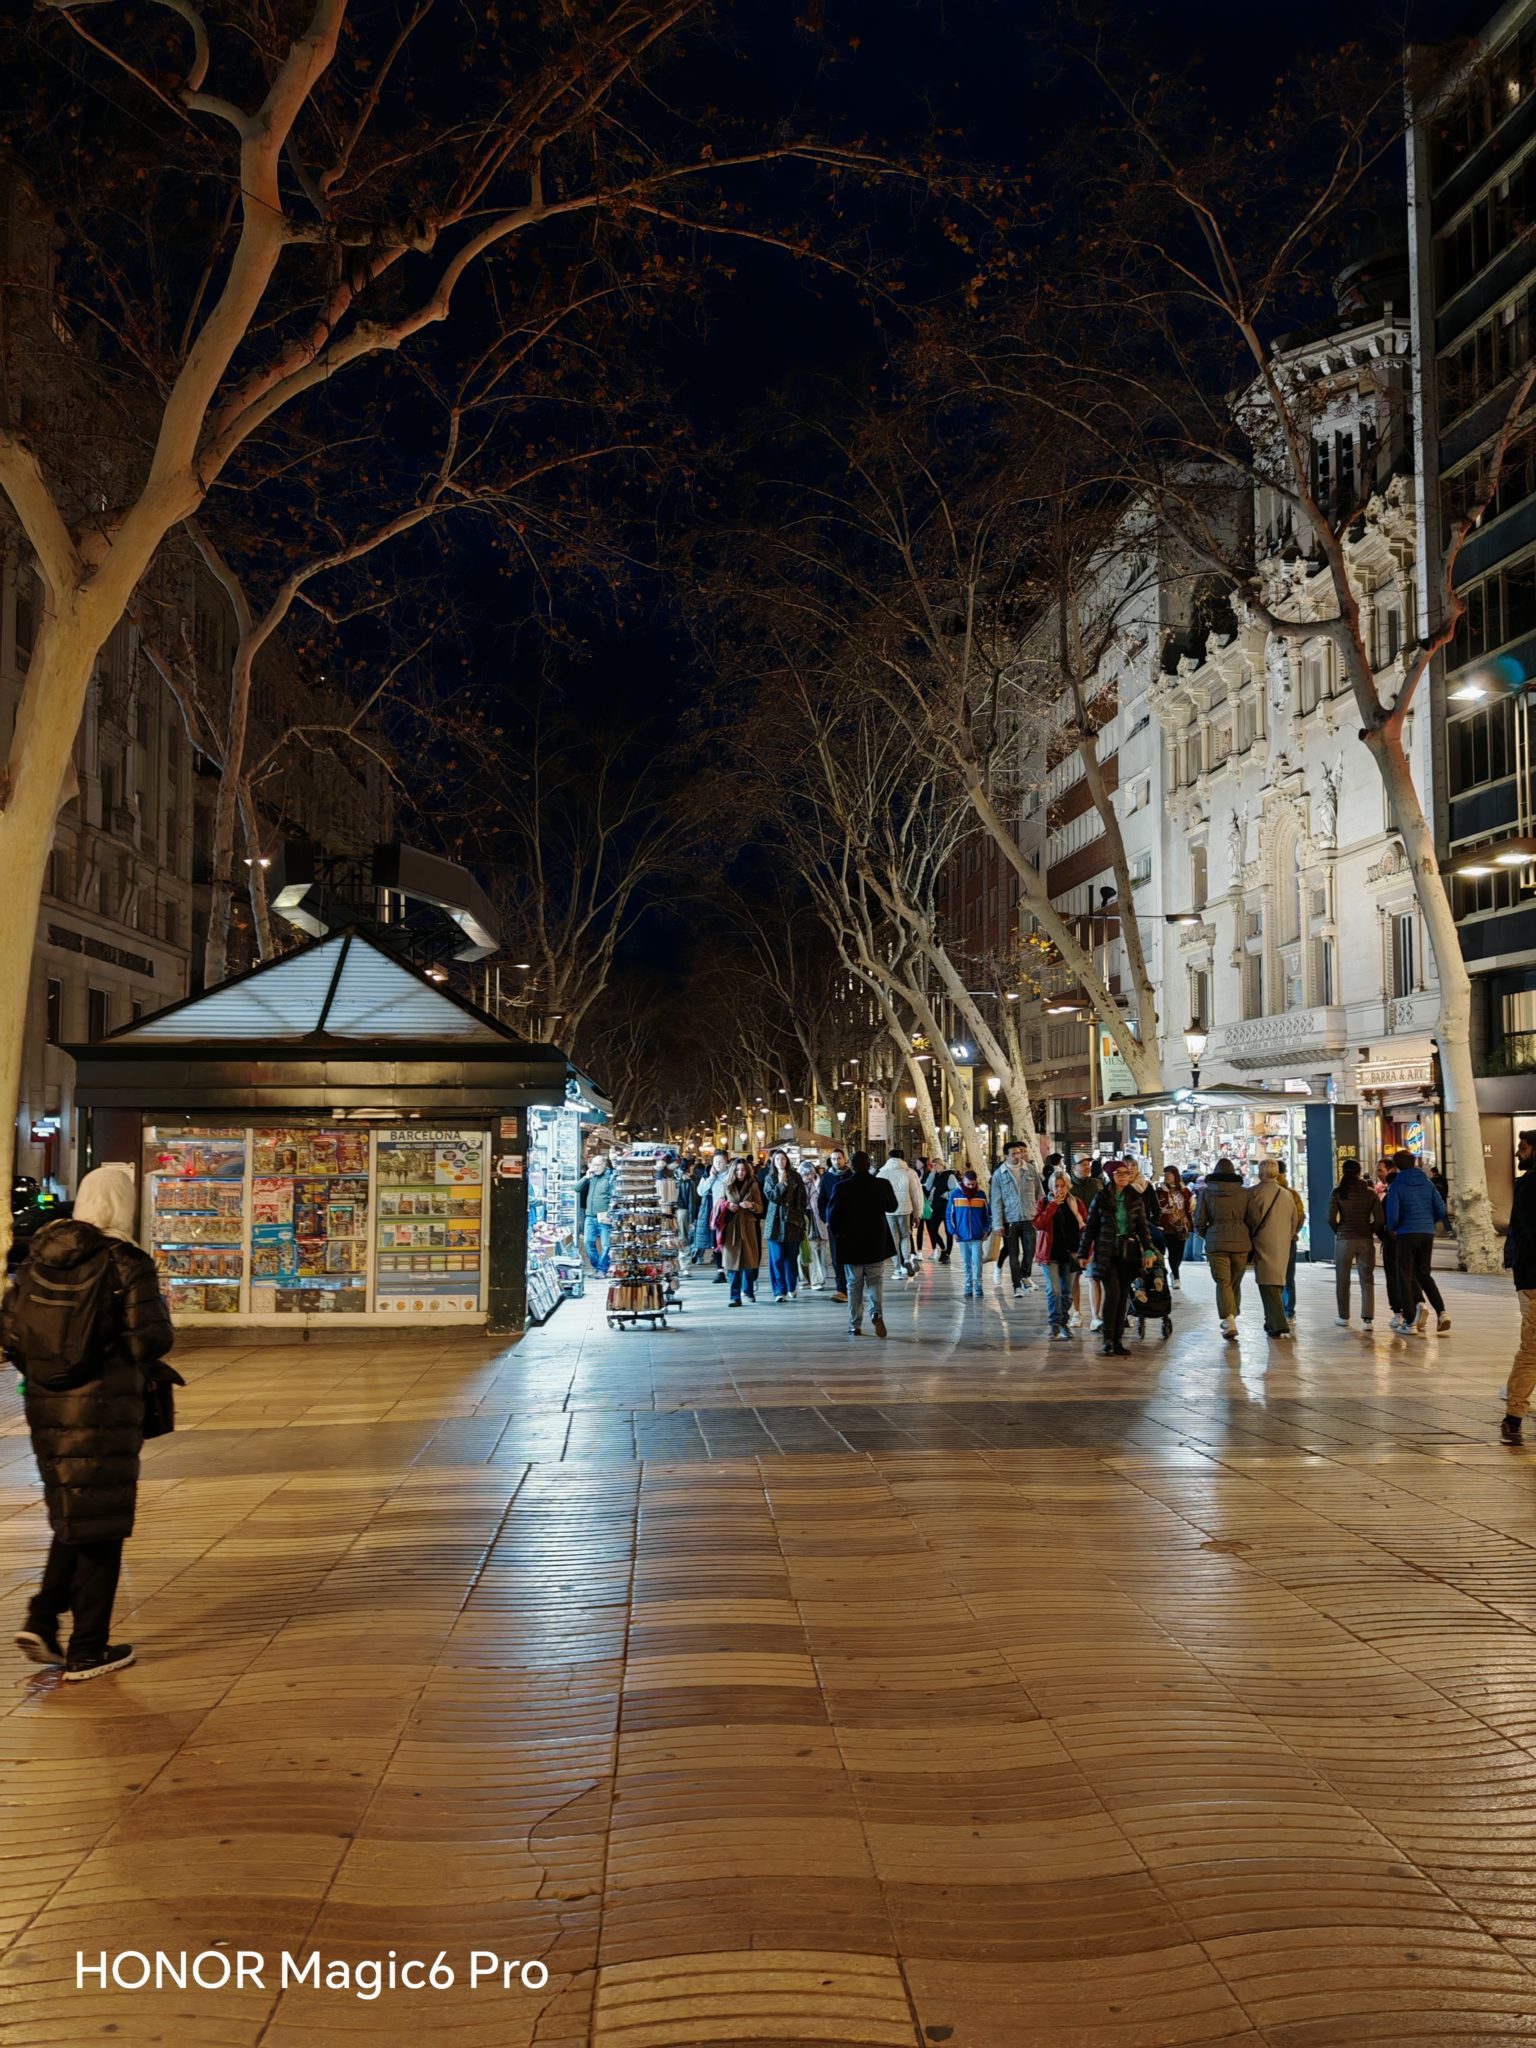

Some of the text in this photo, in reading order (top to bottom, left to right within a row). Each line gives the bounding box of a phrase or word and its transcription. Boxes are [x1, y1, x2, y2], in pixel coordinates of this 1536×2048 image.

[1370, 1070, 1397, 1083] BARRA
[1407, 1068, 1424, 1080] ART
[390, 1130, 461, 1141] BARCELONA
[951, 1138, 959, 1147] P
